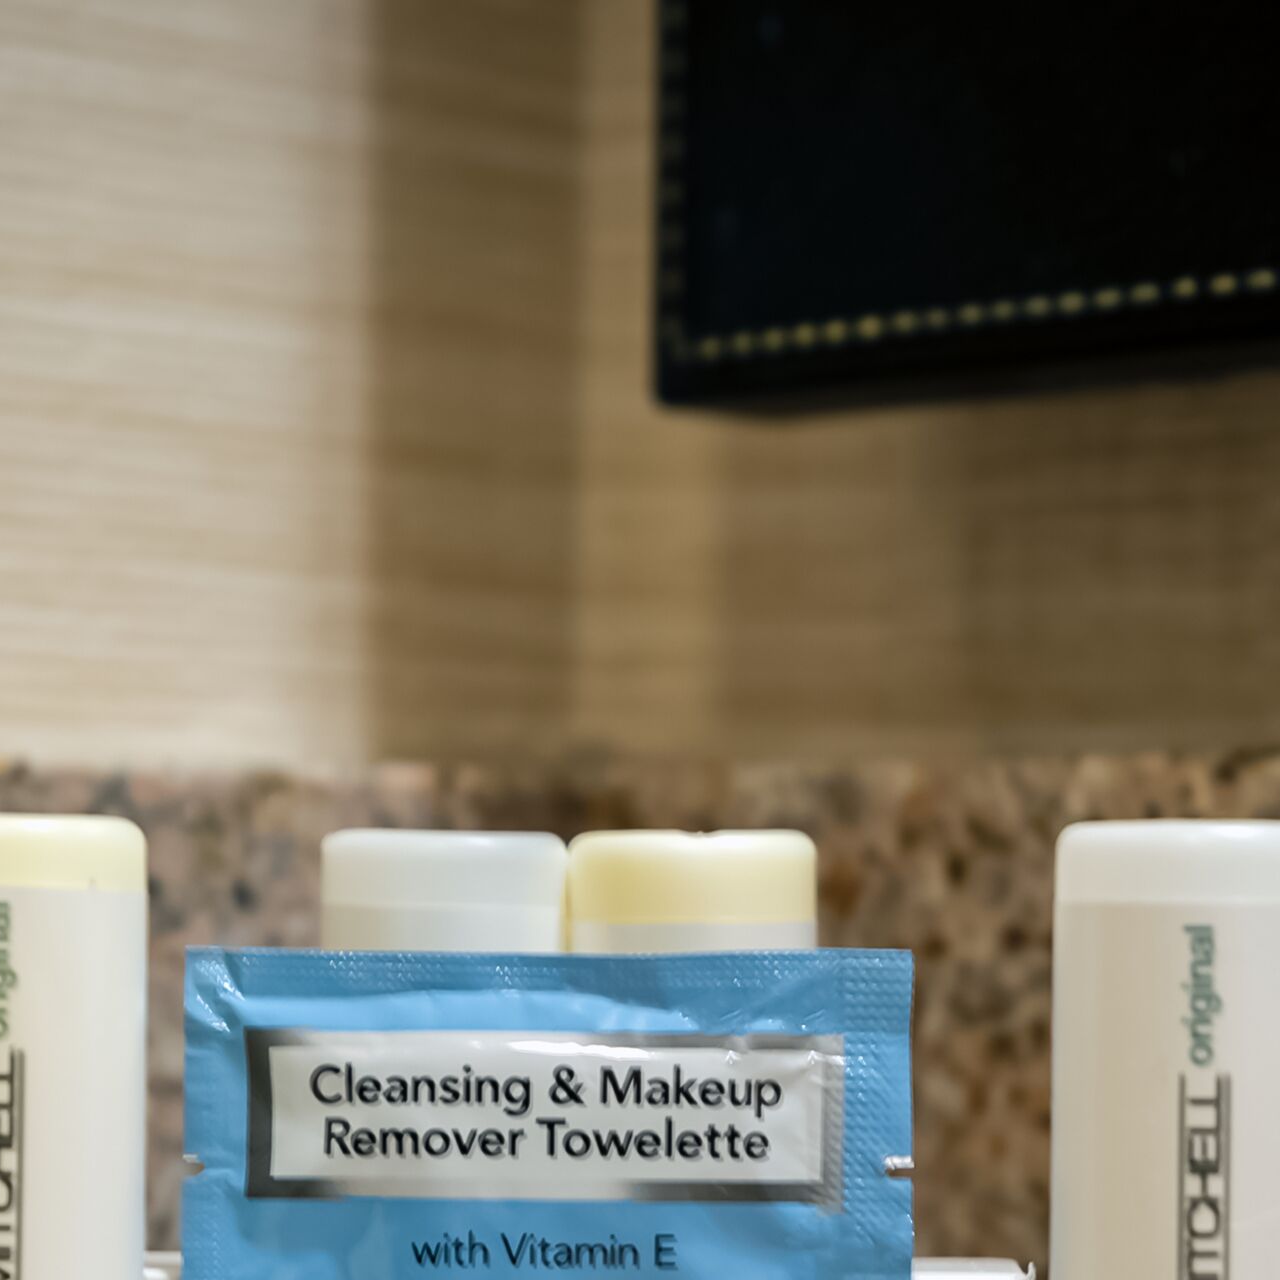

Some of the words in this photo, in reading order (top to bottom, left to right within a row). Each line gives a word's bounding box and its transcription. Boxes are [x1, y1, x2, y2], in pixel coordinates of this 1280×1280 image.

[1181, 924, 1223, 1068] original
[309, 1062, 531, 1117] Cleansing
[549, 1064, 585, 1106] &
[600, 1063, 782, 1119] Makeup
[324, 1116, 526, 1158] Remover
[536, 1116, 770, 1160] Towelette
[411, 1230, 490, 1269] with
[500, 1232, 640, 1270] Vitamin
[654, 1233, 678, 1270] E
